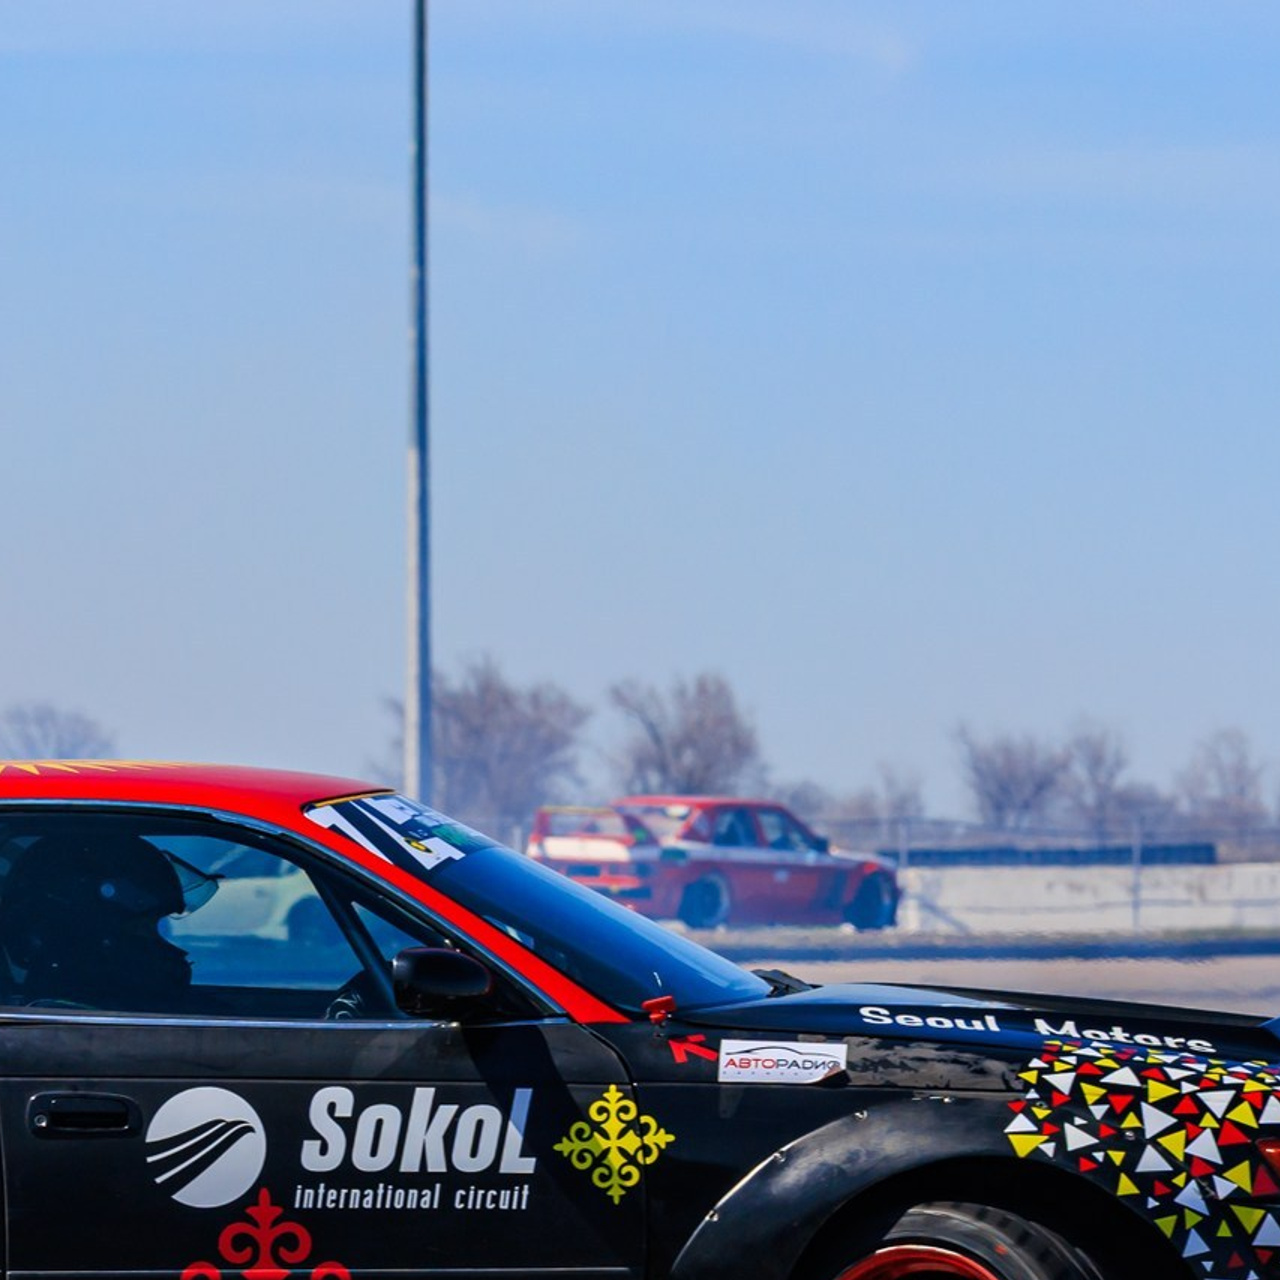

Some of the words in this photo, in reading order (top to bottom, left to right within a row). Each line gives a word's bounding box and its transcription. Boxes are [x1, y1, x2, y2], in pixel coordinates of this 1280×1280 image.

[858, 1006, 1001, 1032] Seoul
[1033, 1018, 1217, 1053] Motors
[294, 1183, 441, 1209] international
[455, 1184, 530, 1210] circuit
